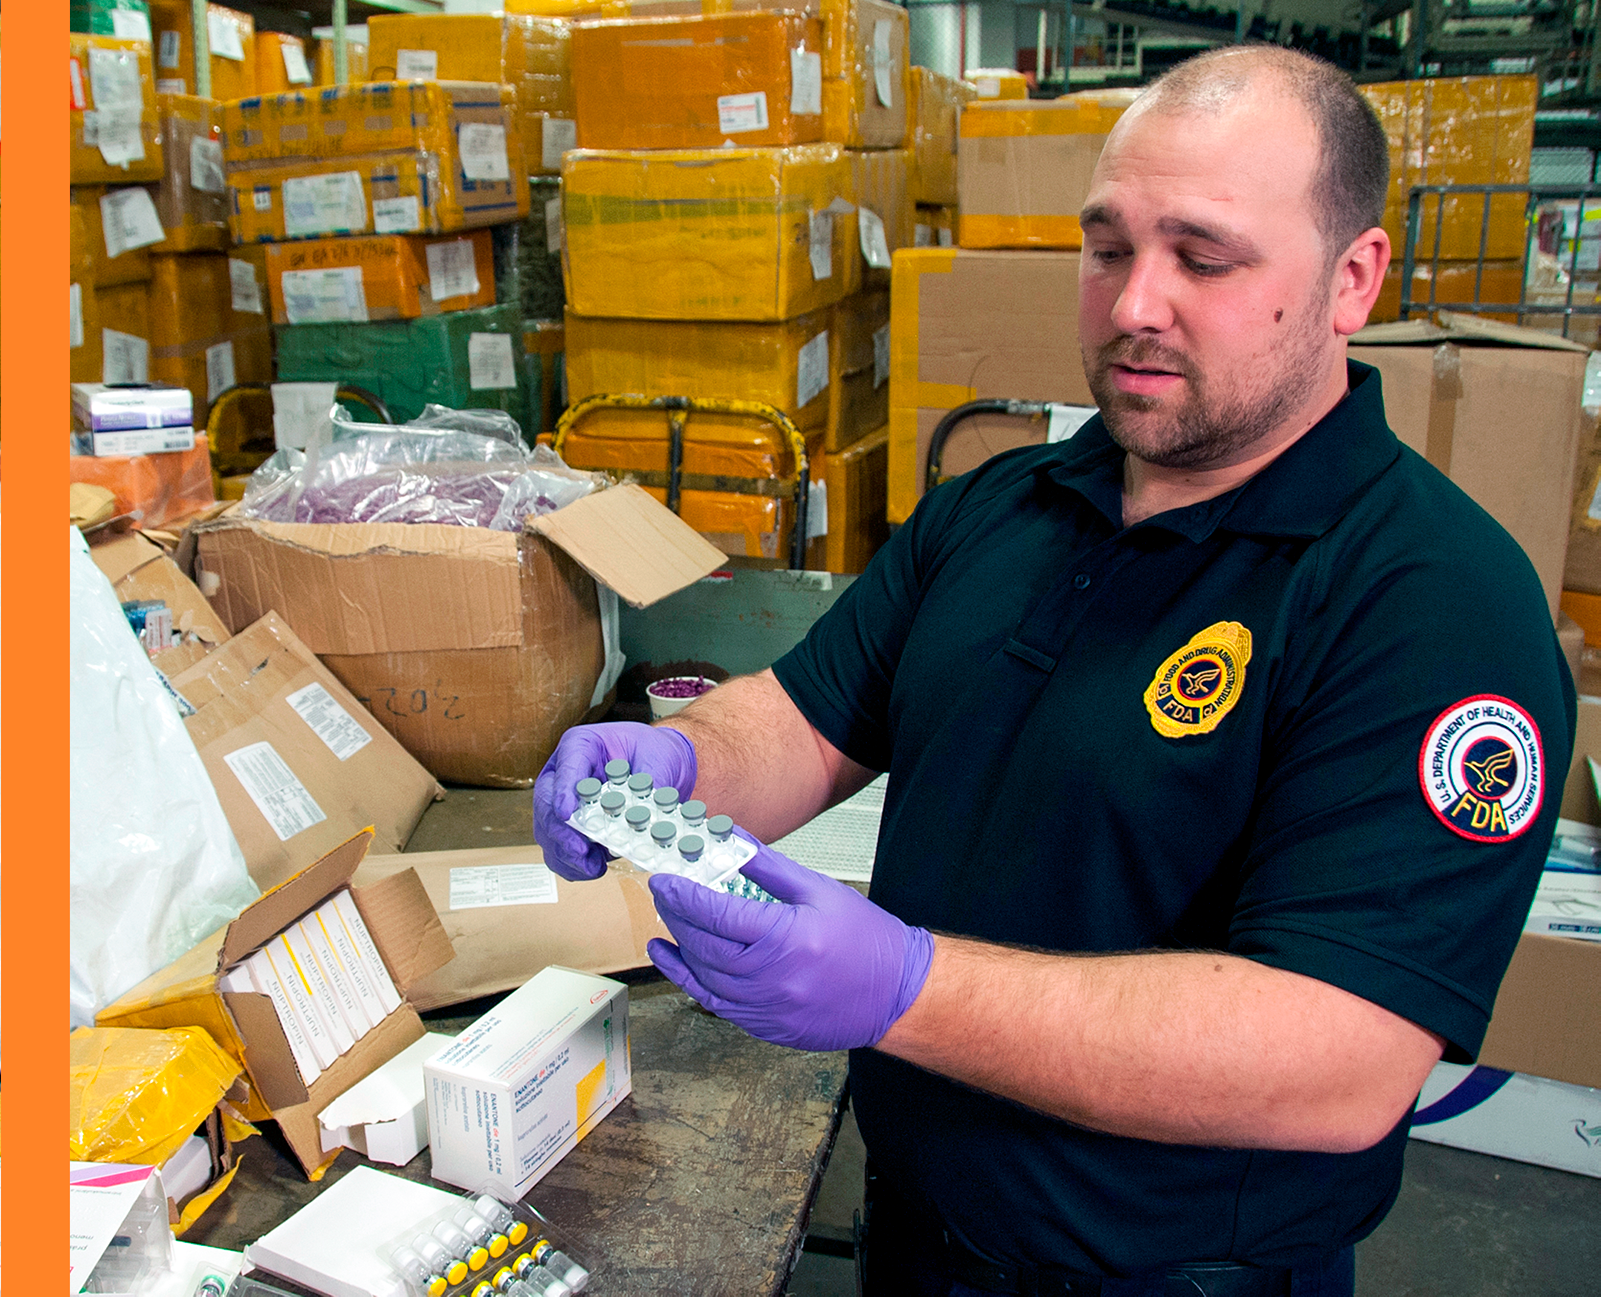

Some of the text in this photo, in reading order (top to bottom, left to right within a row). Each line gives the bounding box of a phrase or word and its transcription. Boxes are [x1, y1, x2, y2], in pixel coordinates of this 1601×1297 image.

[1164, 647, 1236, 707] FOOD AND DRUG ADMINISTRATION
[1163, 700, 1193, 722] FDA
[1467, 708, 1480, 720] OF
[1482, 706, 1516, 724] HEALTH
[1515, 721, 1531, 742] AND
[1433, 714, 1465, 777] DEPARTMENT
[1527, 741, 1538, 781] HUMAN
[1451, 793, 1507, 832] FDA
[1509, 781, 1537, 824] SERVICES
[337, 938, 368, 998] NUPTROPIN
[354, 918, 385, 977] NUPTROPIN
[306, 954, 337, 1015] NUPTROPIN
[321, 949, 353, 1010] NUPTROPIN
[272, 981, 304, 1044] NUPTROPIN
[287, 974, 319, 1037] NUPTROPIN
[515, 1073, 538, 1099] ENANTONE
[549, 1060, 555, 1070] mg
[516, 1085, 535, 1106] soluzione
[493, 1143, 499, 1153] mg
[496, 1167, 502, 1175] ml
